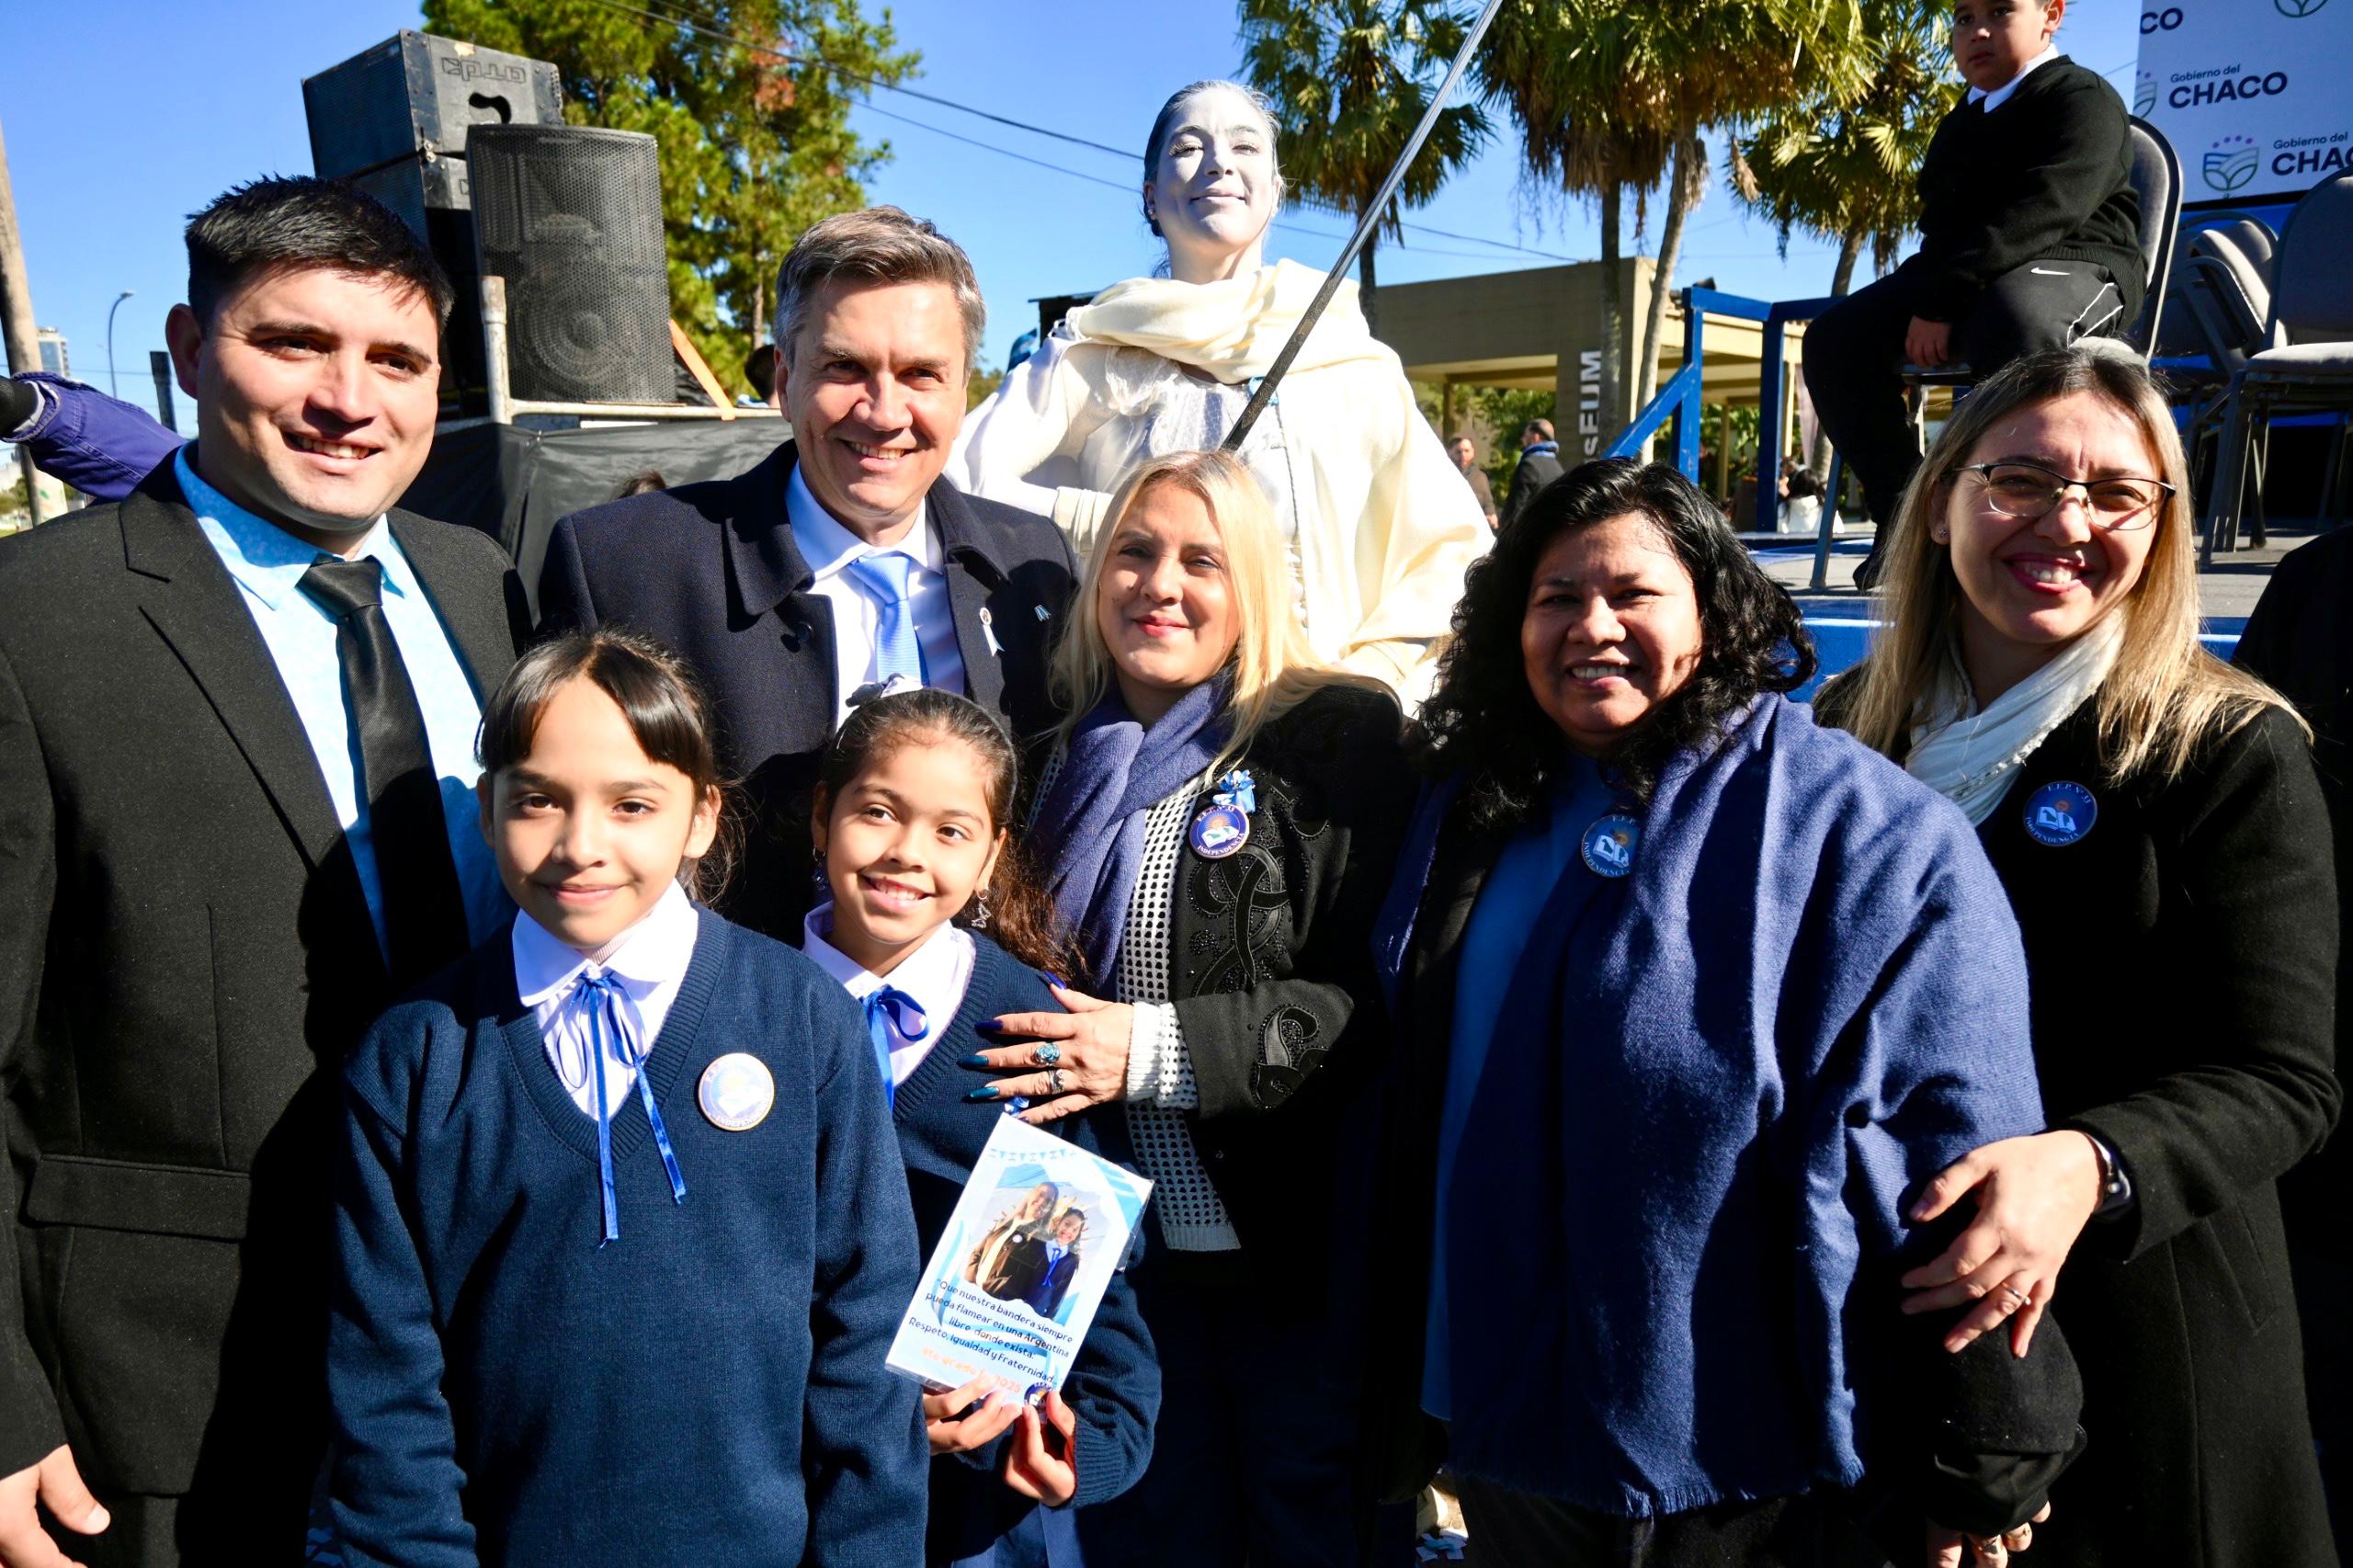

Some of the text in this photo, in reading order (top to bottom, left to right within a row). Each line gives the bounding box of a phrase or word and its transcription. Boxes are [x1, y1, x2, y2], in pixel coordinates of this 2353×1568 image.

[2170, 63, 2241, 83] Gobierno del
[2168, 72, 2288, 109] CHACO
[2273, 132, 2348, 150] Gobierno del
[1579, 350, 1602, 464] SEUM
[925, 1291, 1070, 1358] pueda flamear en una Argentina
[959, 1290, 995, 1310] nuestra
[996, 1303, 1035, 1327] bandera
[1036, 1324, 1073, 1343] siempre
[949, 1335, 990, 1357] Igualdad
[990, 1351, 997, 1360] y
[973, 1326, 1004, 1346] donde
